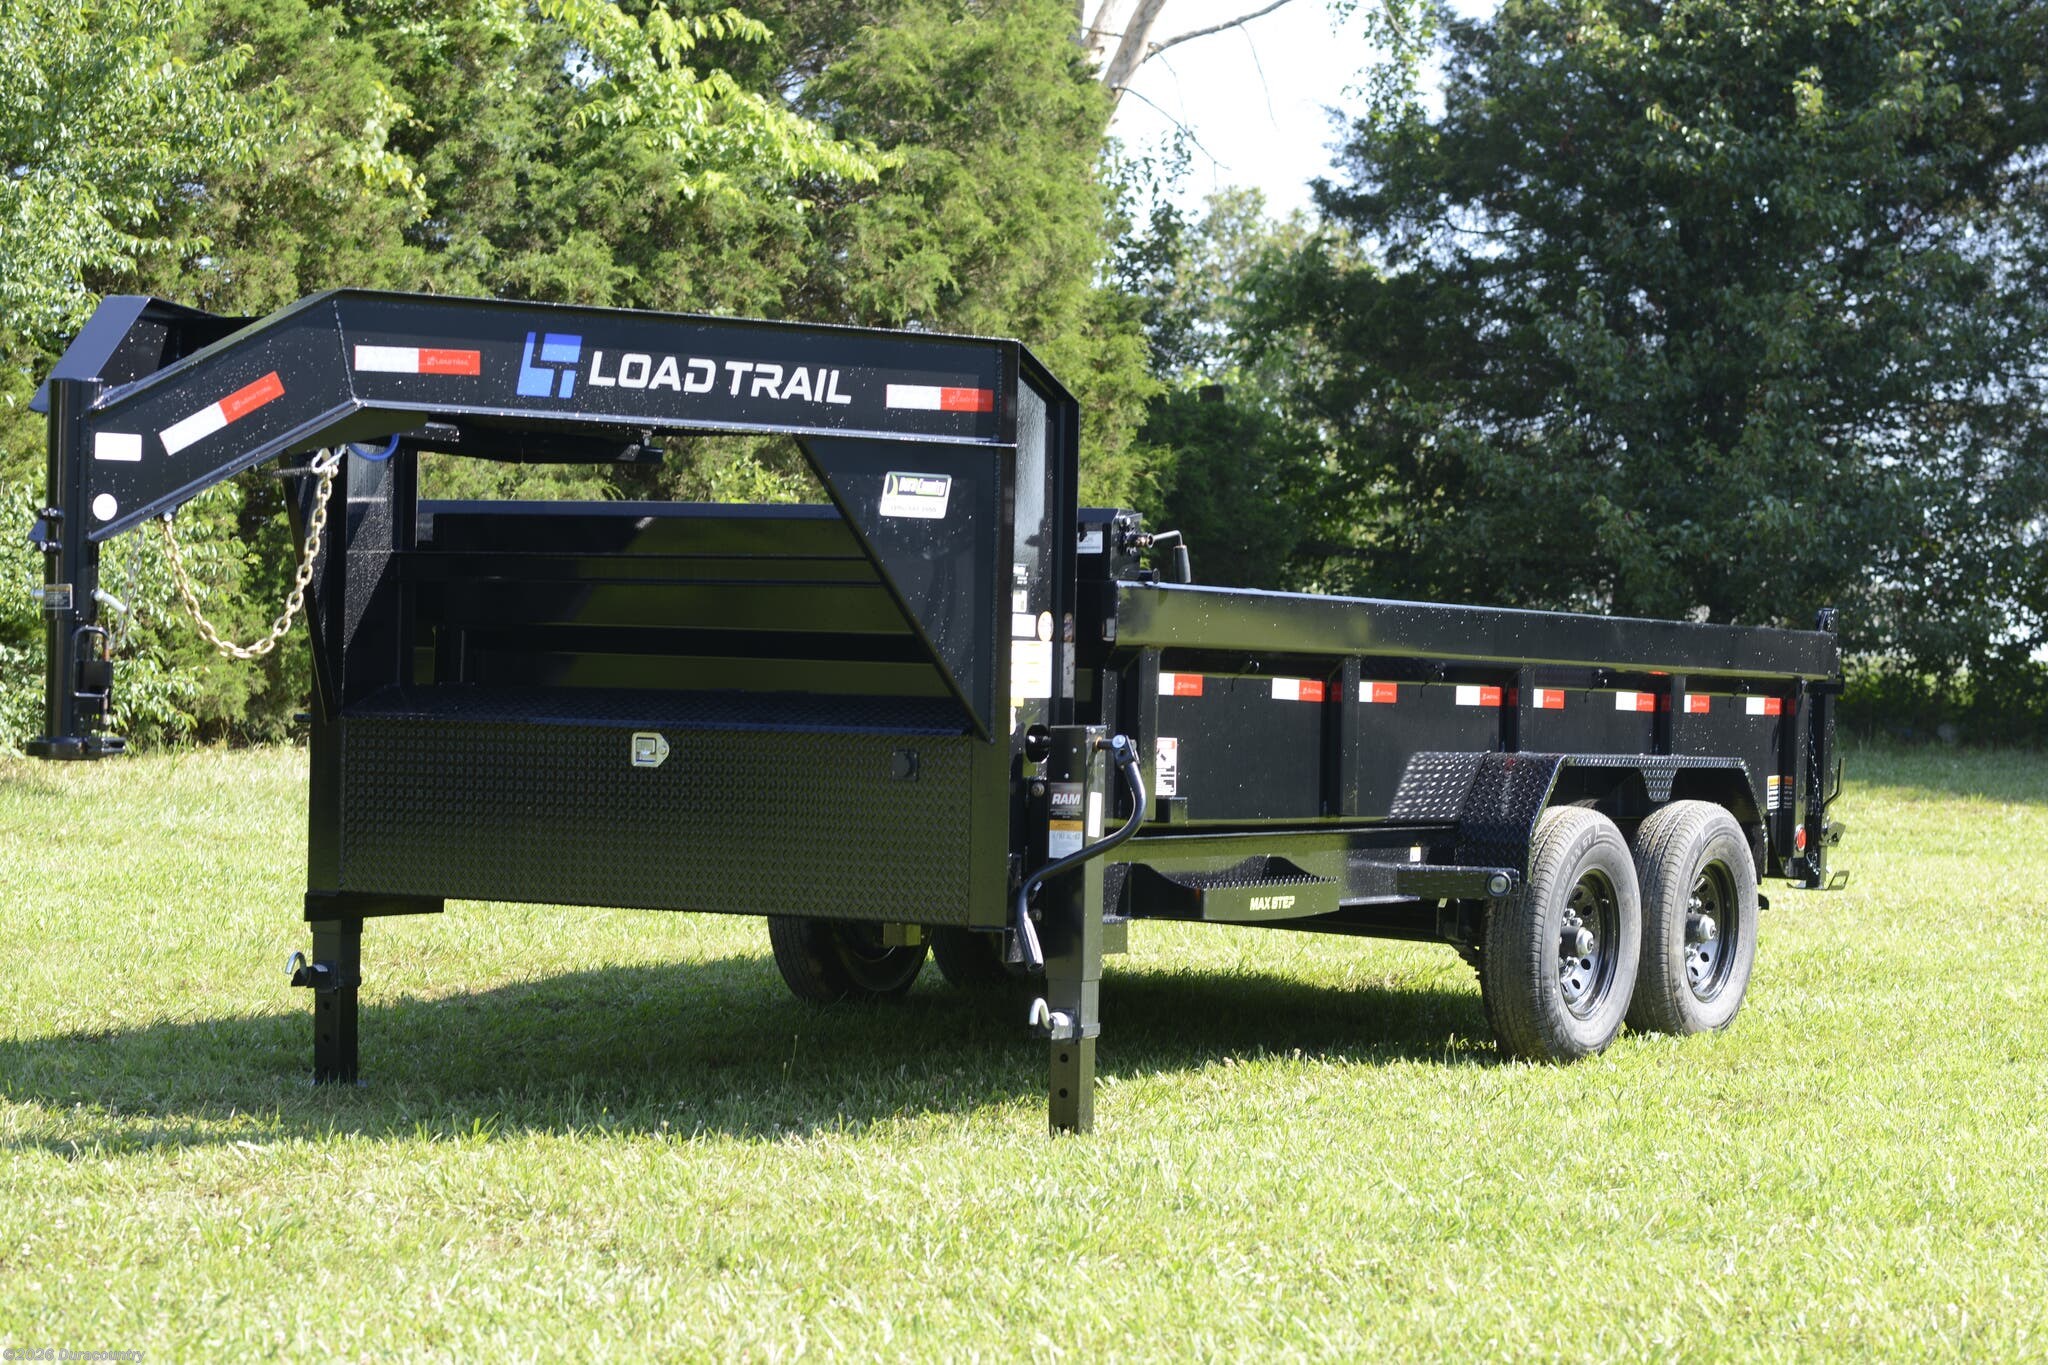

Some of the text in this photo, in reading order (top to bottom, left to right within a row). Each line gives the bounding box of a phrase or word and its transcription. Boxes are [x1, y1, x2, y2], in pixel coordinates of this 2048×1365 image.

[588, 350, 852, 405] LOAD TRAIL
[1051, 793, 1081, 805] RAM
[1249, 895, 1296, 911] MAX STEP
